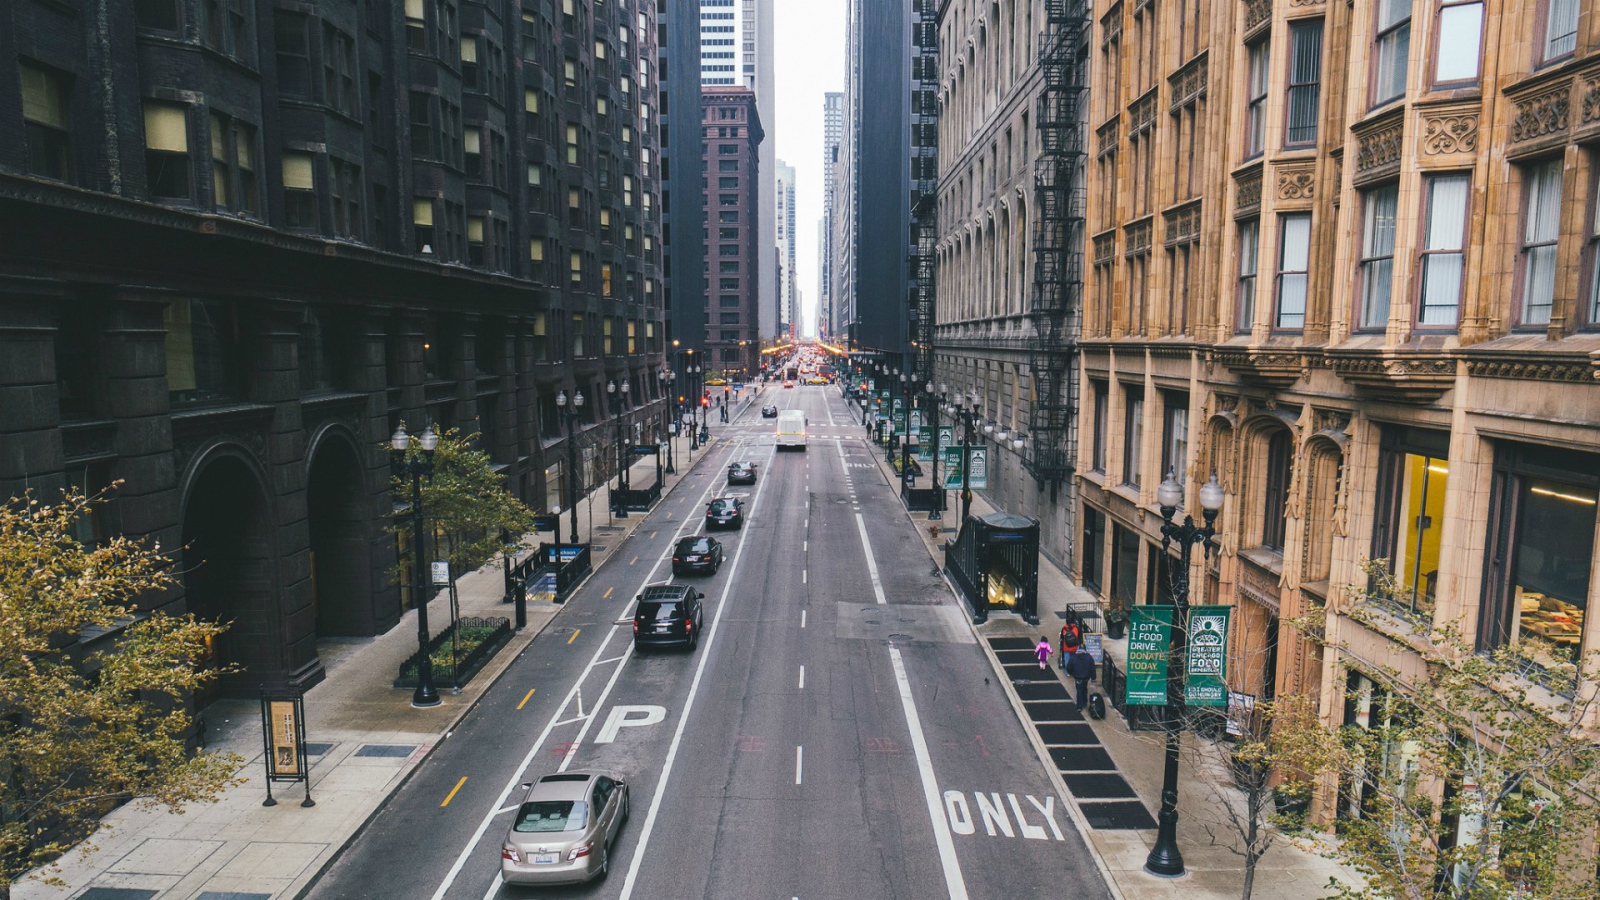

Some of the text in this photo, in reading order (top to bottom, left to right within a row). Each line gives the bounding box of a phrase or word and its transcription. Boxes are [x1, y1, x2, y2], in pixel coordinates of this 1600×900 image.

[1132, 622, 1137, 631] 1
[1131, 632, 1136, 640] 1
[1130, 642, 1158, 651] DRIVE.
[1130, 652, 1165, 661] DONATE
[1191, 659, 1221, 667] FOOD
[594, 705, 667, 743] P
[943, 790, 1066, 841] ONLY
